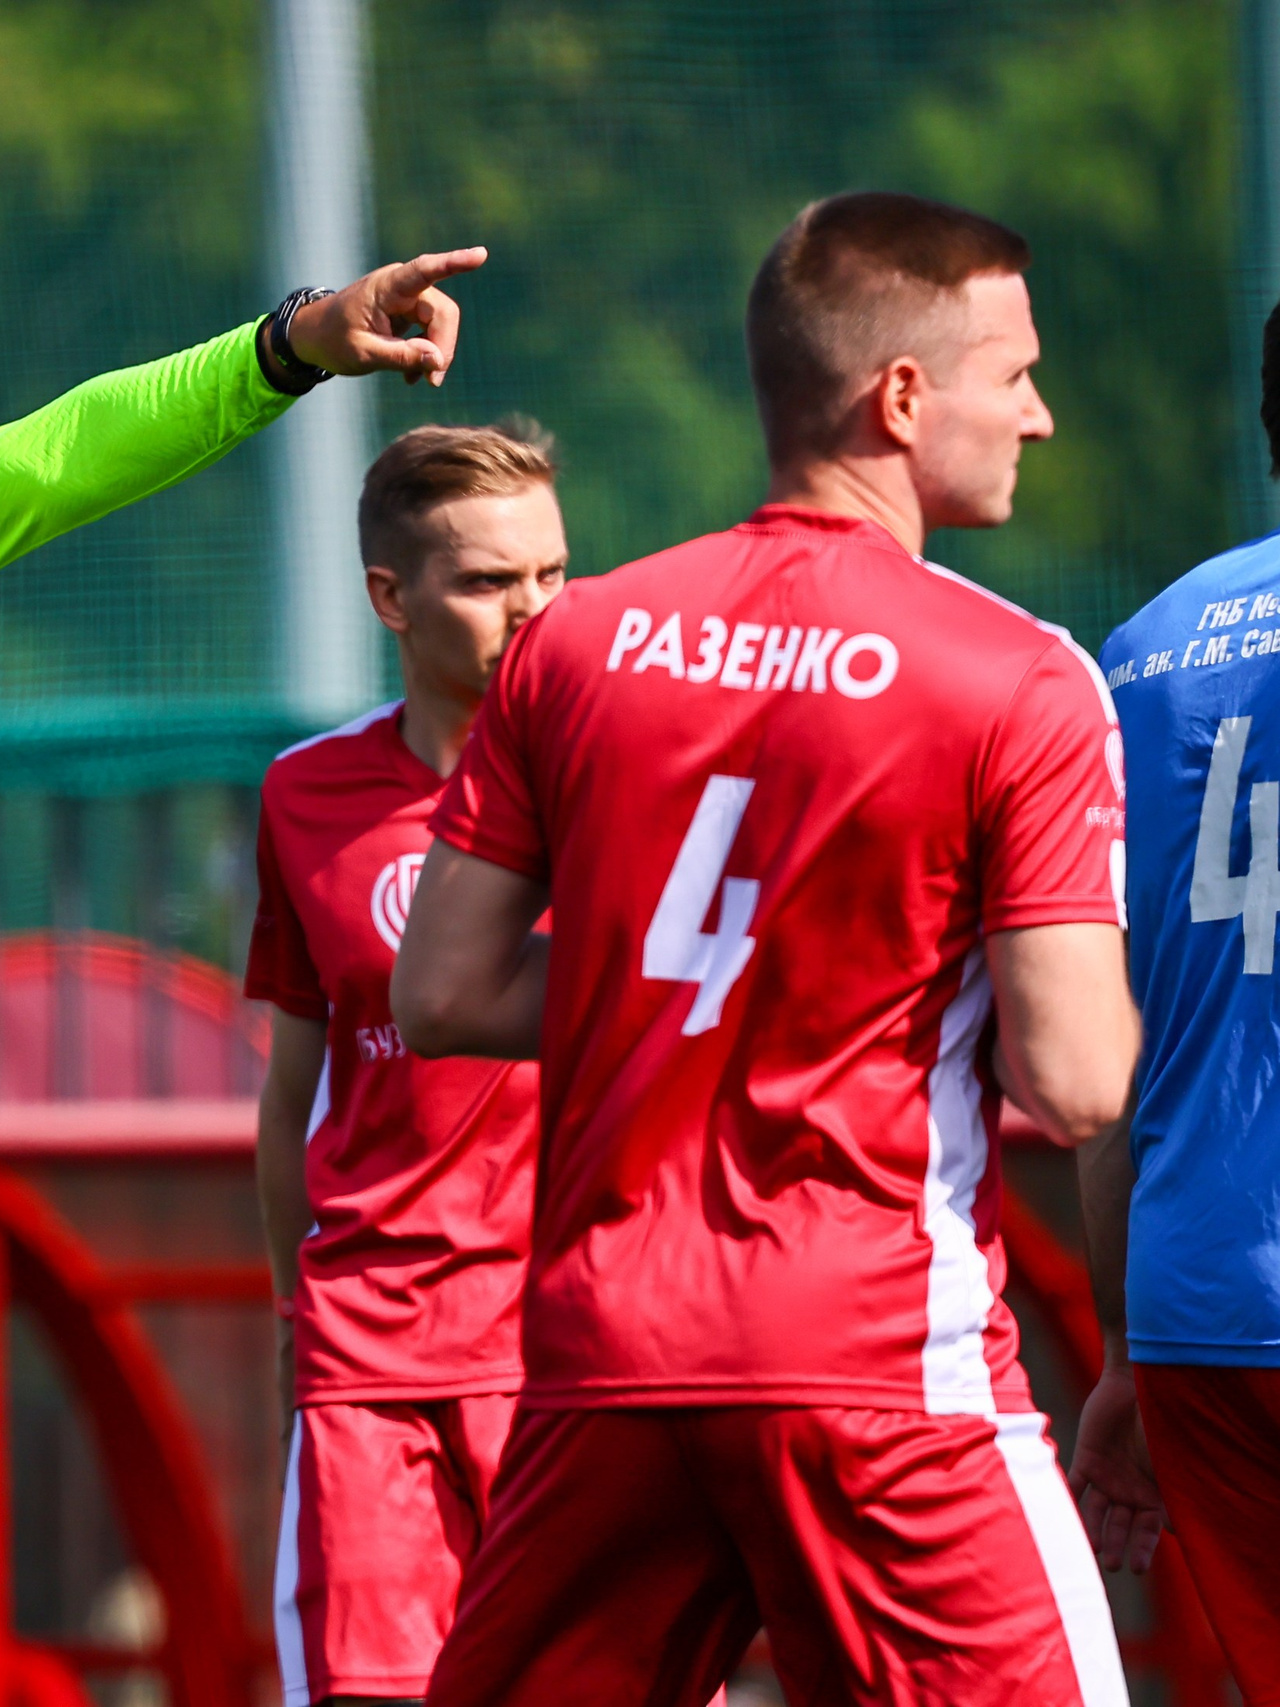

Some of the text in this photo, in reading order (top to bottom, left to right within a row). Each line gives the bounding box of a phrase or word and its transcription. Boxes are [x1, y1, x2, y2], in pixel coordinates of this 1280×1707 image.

[607, 608, 899, 699] РАЗЕНКО
[1144, 650, 1175, 678] ак.
[1181, 635, 1233, 668] Г.М.
[642, 774, 761, 1036] 4
[1189, 715, 1280, 975] 4
